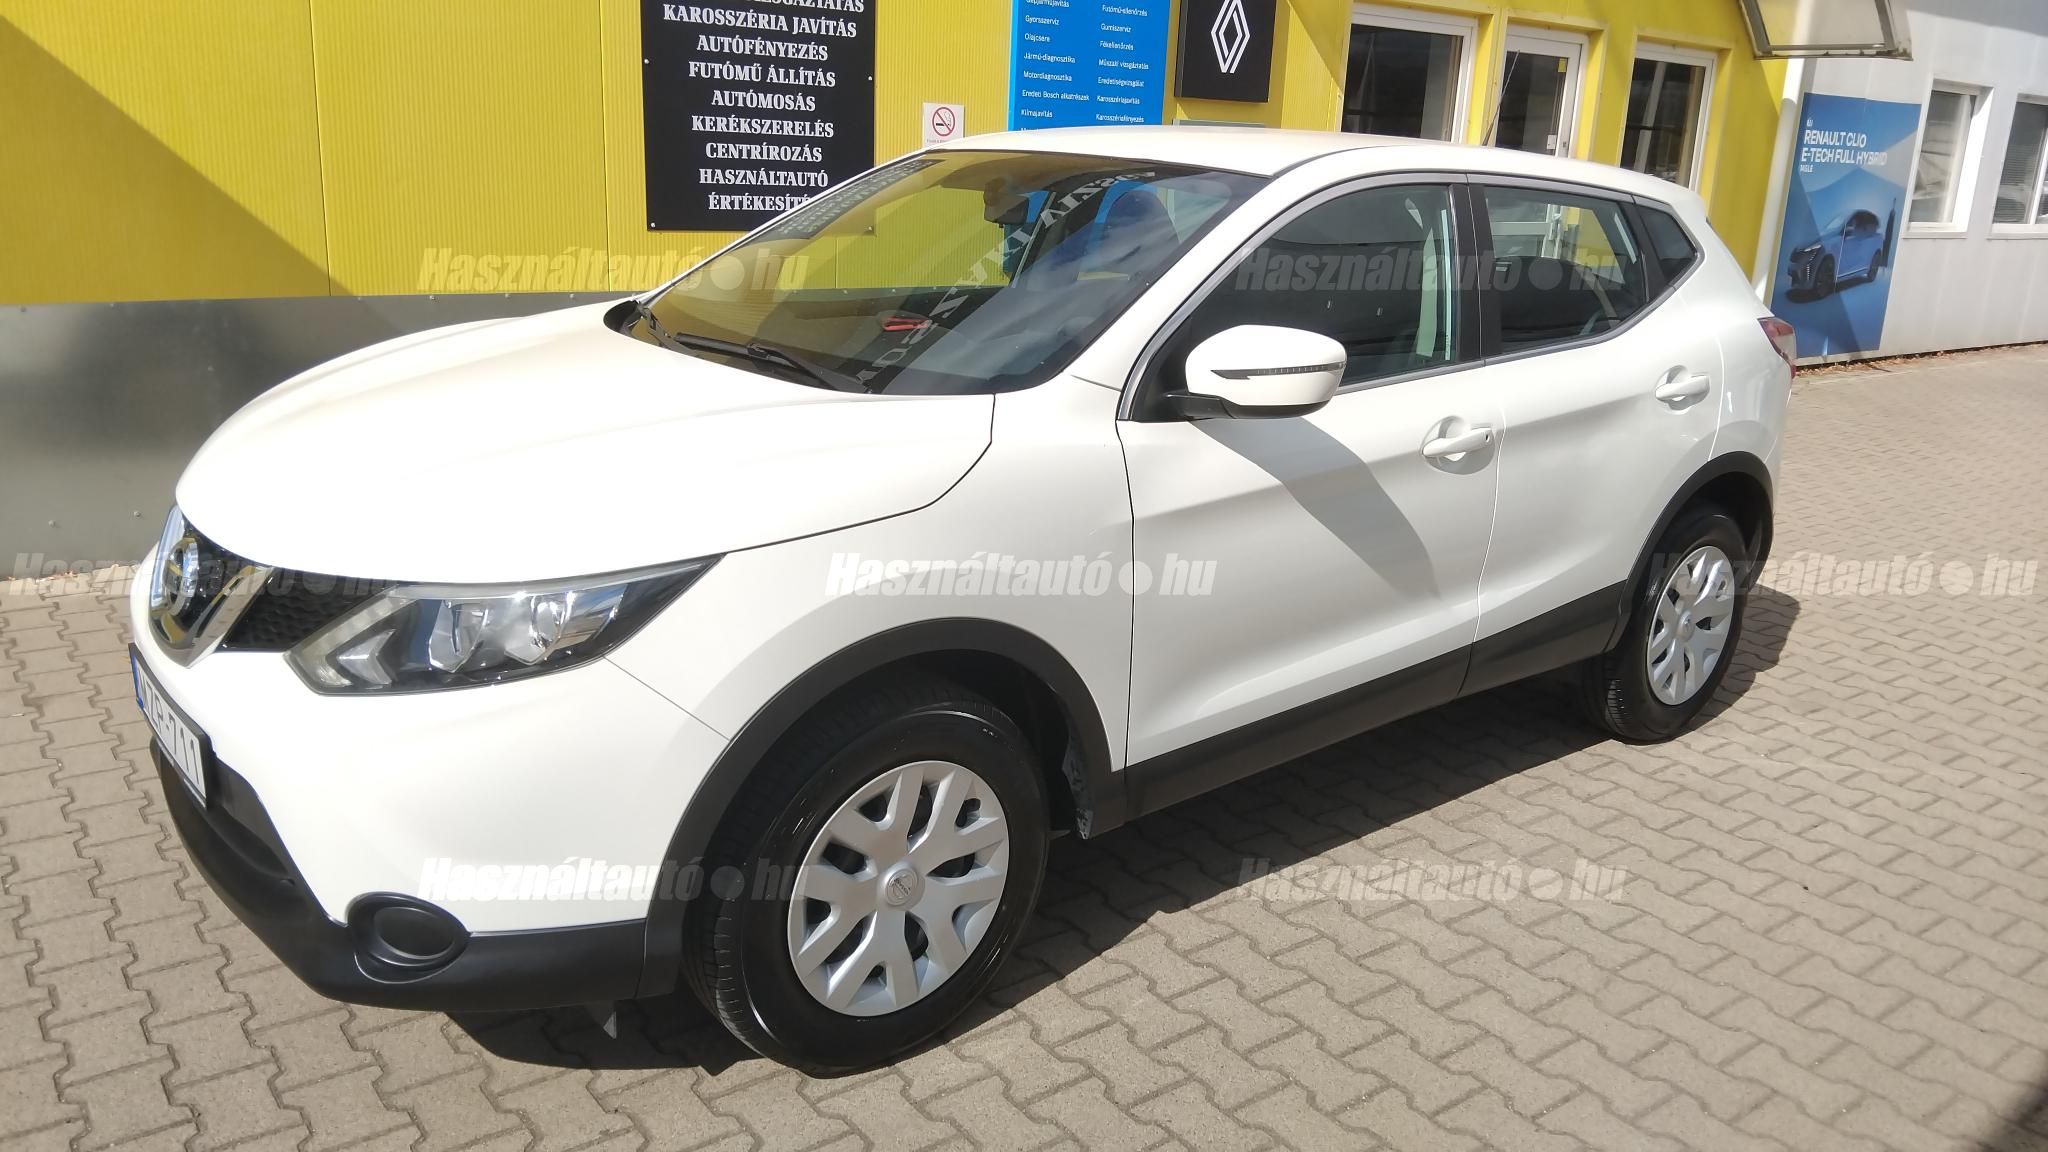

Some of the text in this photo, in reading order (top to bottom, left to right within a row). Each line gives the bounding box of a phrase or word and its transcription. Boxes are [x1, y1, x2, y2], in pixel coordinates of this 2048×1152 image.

[663, 4, 857, 38] KAROSSZÉRIA JAVÍTÁS
[697, 35, 828, 61] AUTÓFÉNYEZÉS
[689, 61, 836, 87] FUTÓMŰ ÁLLÍTÁS
[711, 89, 816, 111] AUTÓMOSÁS
[691, 115, 834, 138] KERÉKSZERELÉS
[1804, 129, 1867, 148] RENAULT CLIO
[705, 142, 822, 162] CENTRÍROZÁS
[1801, 147, 1834, 162] E-TECH
[1835, 149, 1855, 164] FULL
[699, 168, 828, 188] HASZNÁLTAUTÓ
